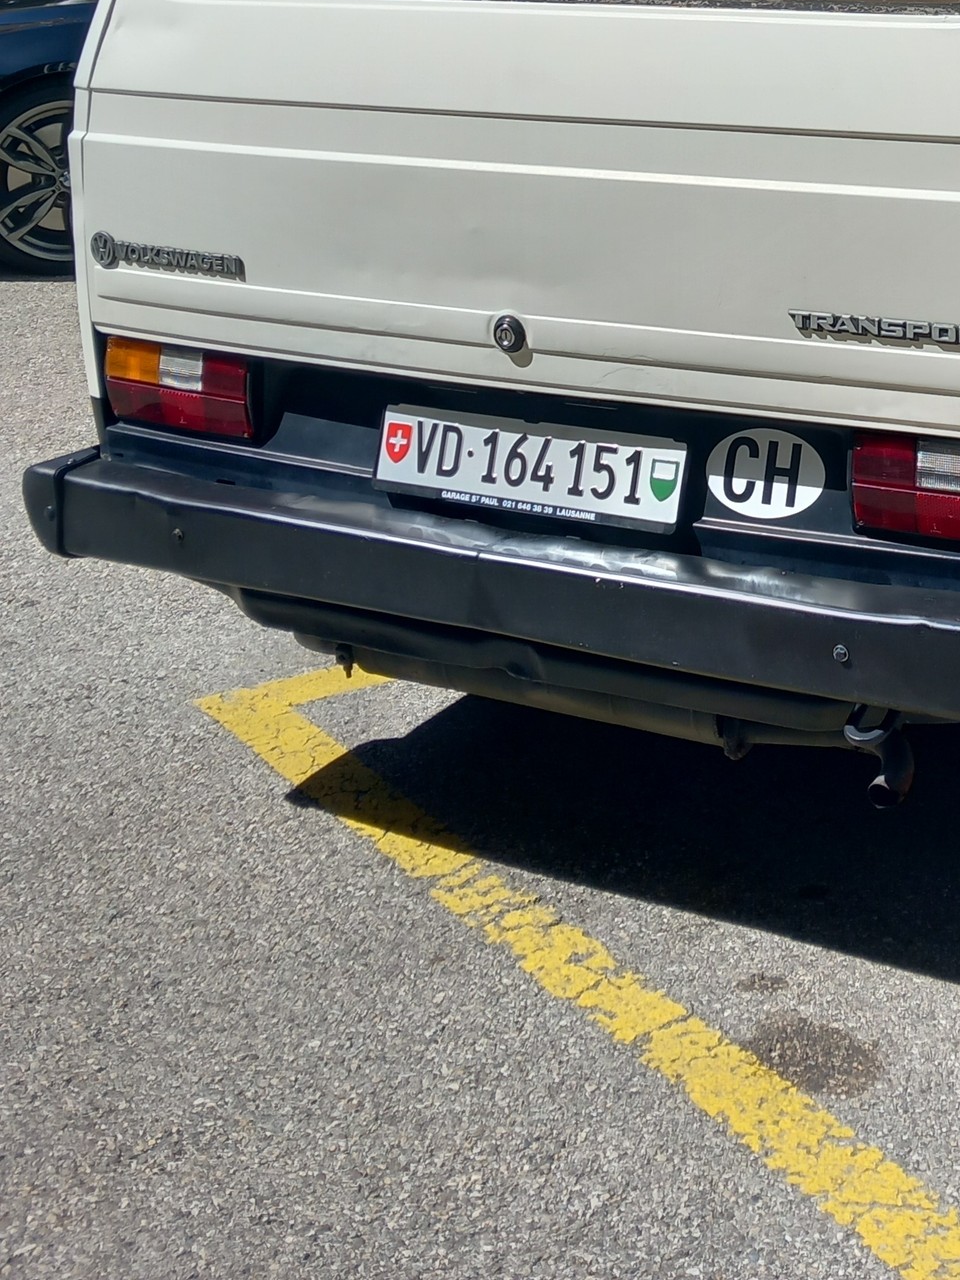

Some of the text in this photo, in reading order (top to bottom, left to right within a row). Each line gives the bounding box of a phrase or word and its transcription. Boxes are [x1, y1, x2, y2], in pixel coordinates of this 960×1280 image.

[114, 241, 240, 273] VOLKSWAGEN
[567, 439, 643, 505] 151
[723, 436, 802, 508] CH
[441, 490, 470, 502] GARAGE
[480, 497, 499, 506] PAUL
[502, 500, 515, 508] 021
[556, 507, 596, 520] LAUSANNE
